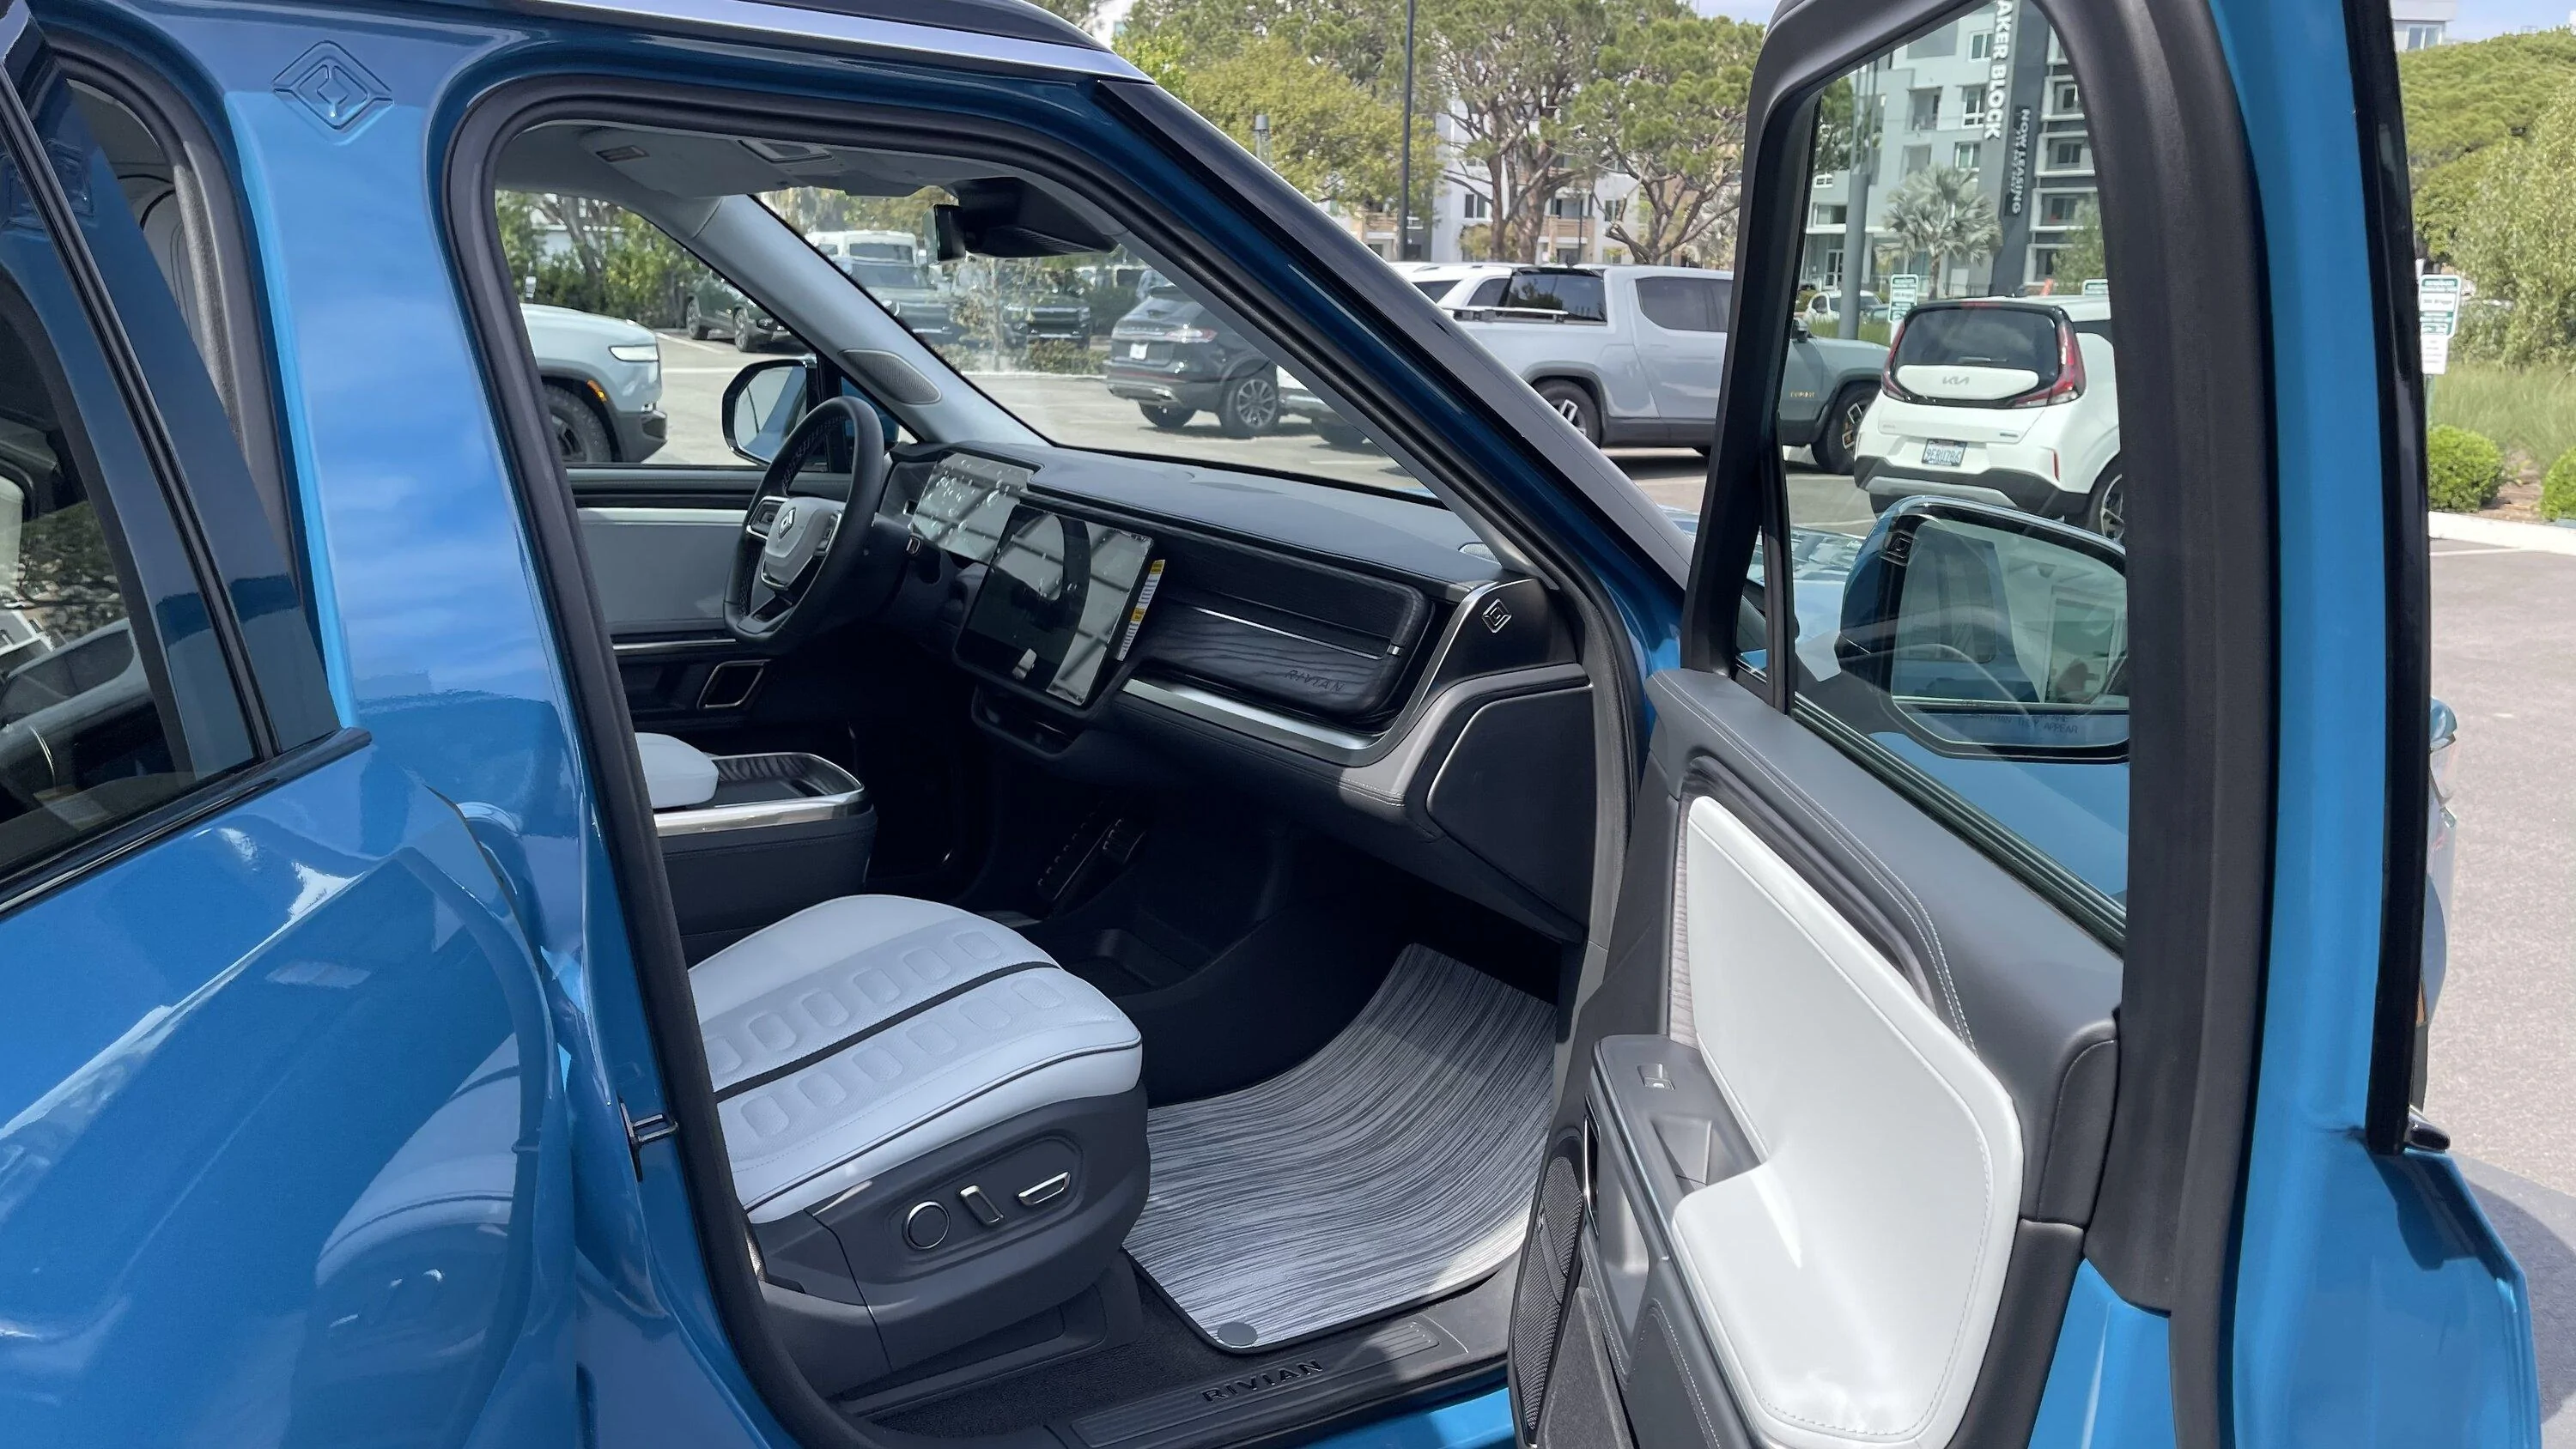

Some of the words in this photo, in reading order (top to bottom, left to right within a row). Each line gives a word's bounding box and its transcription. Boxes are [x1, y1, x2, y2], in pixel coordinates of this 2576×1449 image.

[1984, 64, 2008, 139] BLOCK
[2019, 108, 2030, 149] NOW
[2011, 150, 2026, 215] LEASING
[1284, 669, 1346, 694] RIVIAN
[2044, 722, 2079, 734] APPEAR
[1200, 1358, 1323, 1402] RIVIAN
